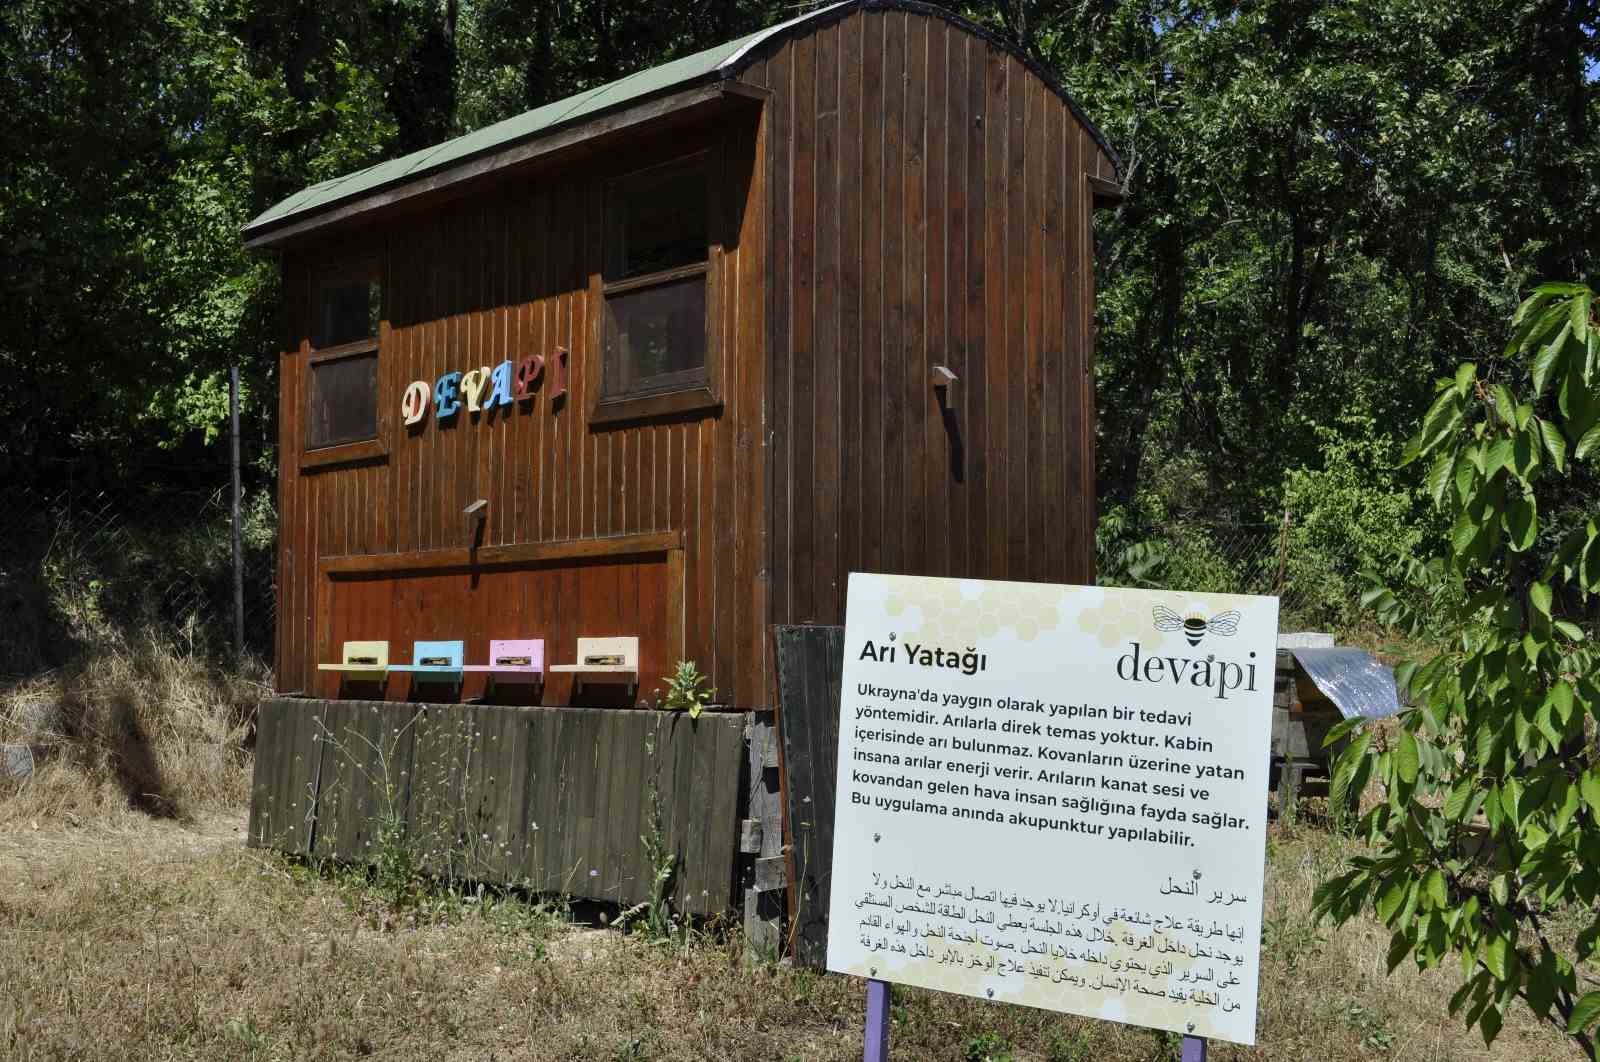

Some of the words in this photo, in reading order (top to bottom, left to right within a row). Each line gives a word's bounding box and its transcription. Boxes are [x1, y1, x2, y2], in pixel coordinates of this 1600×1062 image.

[904, 643, 987, 676] Yatağı
[1117, 642, 1258, 699] devapi
[857, 683, 938, 703] Ukrayna'da
[942, 694, 992, 710] yaygın
[996, 697, 1044, 713] olarak
[1049, 703, 1108, 719] yapılan
[1113, 706, 1134, 721] bir
[1139, 709, 1192, 726] tedavi
[855, 706, 938, 725] yöntemidir.
[942, 714, 997, 732] Arılarla
[1001, 719, 1041, 736] direk
[1046, 725, 1096, 741] temas
[1100, 729, 1159, 747] yoktur.
[1164, 735, 1213, 752] Kabin
[854, 726, 924, 746] içerisinde
[928, 736, 947, 749] arı
[952, 738, 1032, 758] bulunmaz.
[1038, 747, 1123, 767] Kovanların
[1128, 754, 1191, 774] üzerine
[1195, 765, 1245, 780] yatan
[853, 748, 900, 765] insana
[904, 754, 942, 770] arılar
[946, 760, 990, 778] enerji
[994, 765, 1032, 781] verir.
[1037, 769, 1095, 787] Arıların
[1101, 776, 1147, 794] kanat
[1152, 783, 1184, 798] sesi
[1190, 788, 1210, 801] ve
[852, 770, 923, 790] kovandan
[927, 780, 969, 797] gelen
[974, 784, 1010, 801] hava
[1015, 788, 1057, 806] insan
[1062, 796, 1135, 816] sağlığına
[1141, 803, 1186, 823] fayda
[1191, 811, 1249, 830] sağlar.
[851, 792, 870, 805] Bu
[875, 796, 947, 816] uygulama
[952, 805, 1004, 823] anında
[1008, 811, 1104, 835] akupunktur
[1108, 825, 1195, 847] yapılabilir.
[872, 872, 887, 889] ولا
[890, 875, 915, 890] النحل
[916, 884, 931, 898] مع
[1206, 889, 1247, 905] سرير
[1020, 898, 1045, 913] يوجد
[968, 908, 995, 924] النحل
[1153, 914, 1184, 934] علاج
[920, 922, 946, 938] النحل
[1065, 923, 1082, 938] هذه
[1187, 918, 1223, 938] طريقة
[1021, 939, 1048, 955] النحل
[1122, 932, 1155, 951] الغرفة
[1157, 937, 1186, 954] داخل
[909, 944, 934, 959] داخل
[1188, 943, 1213, 959] نحل
[1215, 951, 1244, 967] يوجد
[998, 958, 1024, 976] علاج
[1110, 956, 1147, 973] يحتوي
[1150, 960, 1173, 979] الذي
[1178, 967, 1214, 984] السرير
[1217, 971, 1241, 989] على
[1133, 979, 1166, 998] صحة
[1222, 998, 1241, 1013] من
